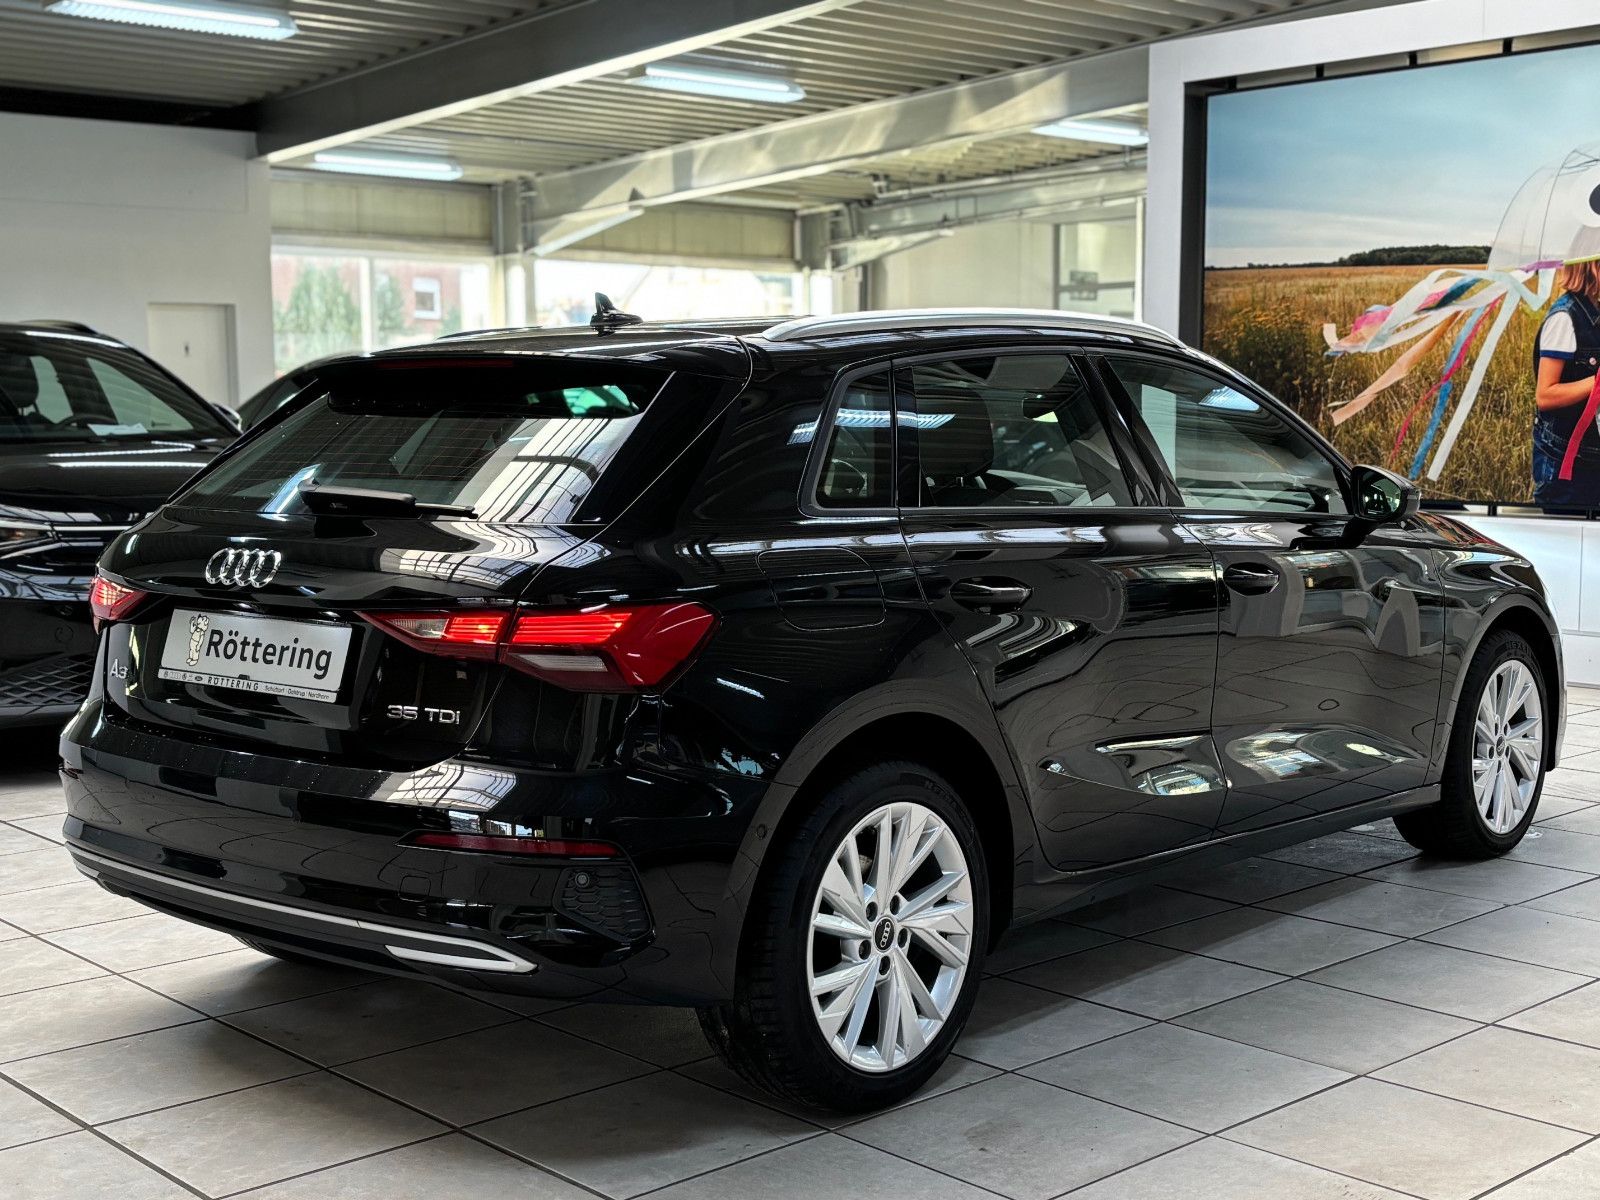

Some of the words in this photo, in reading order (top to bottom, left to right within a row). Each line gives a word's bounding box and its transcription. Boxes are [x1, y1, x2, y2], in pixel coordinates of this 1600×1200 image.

[206, 629, 332, 680] Röttering
[110, 659, 129, 679] A3
[207, 676, 259, 691] RÖTTERING
[386, 704, 418, 721] 35
[425, 707, 461, 725] TDI
